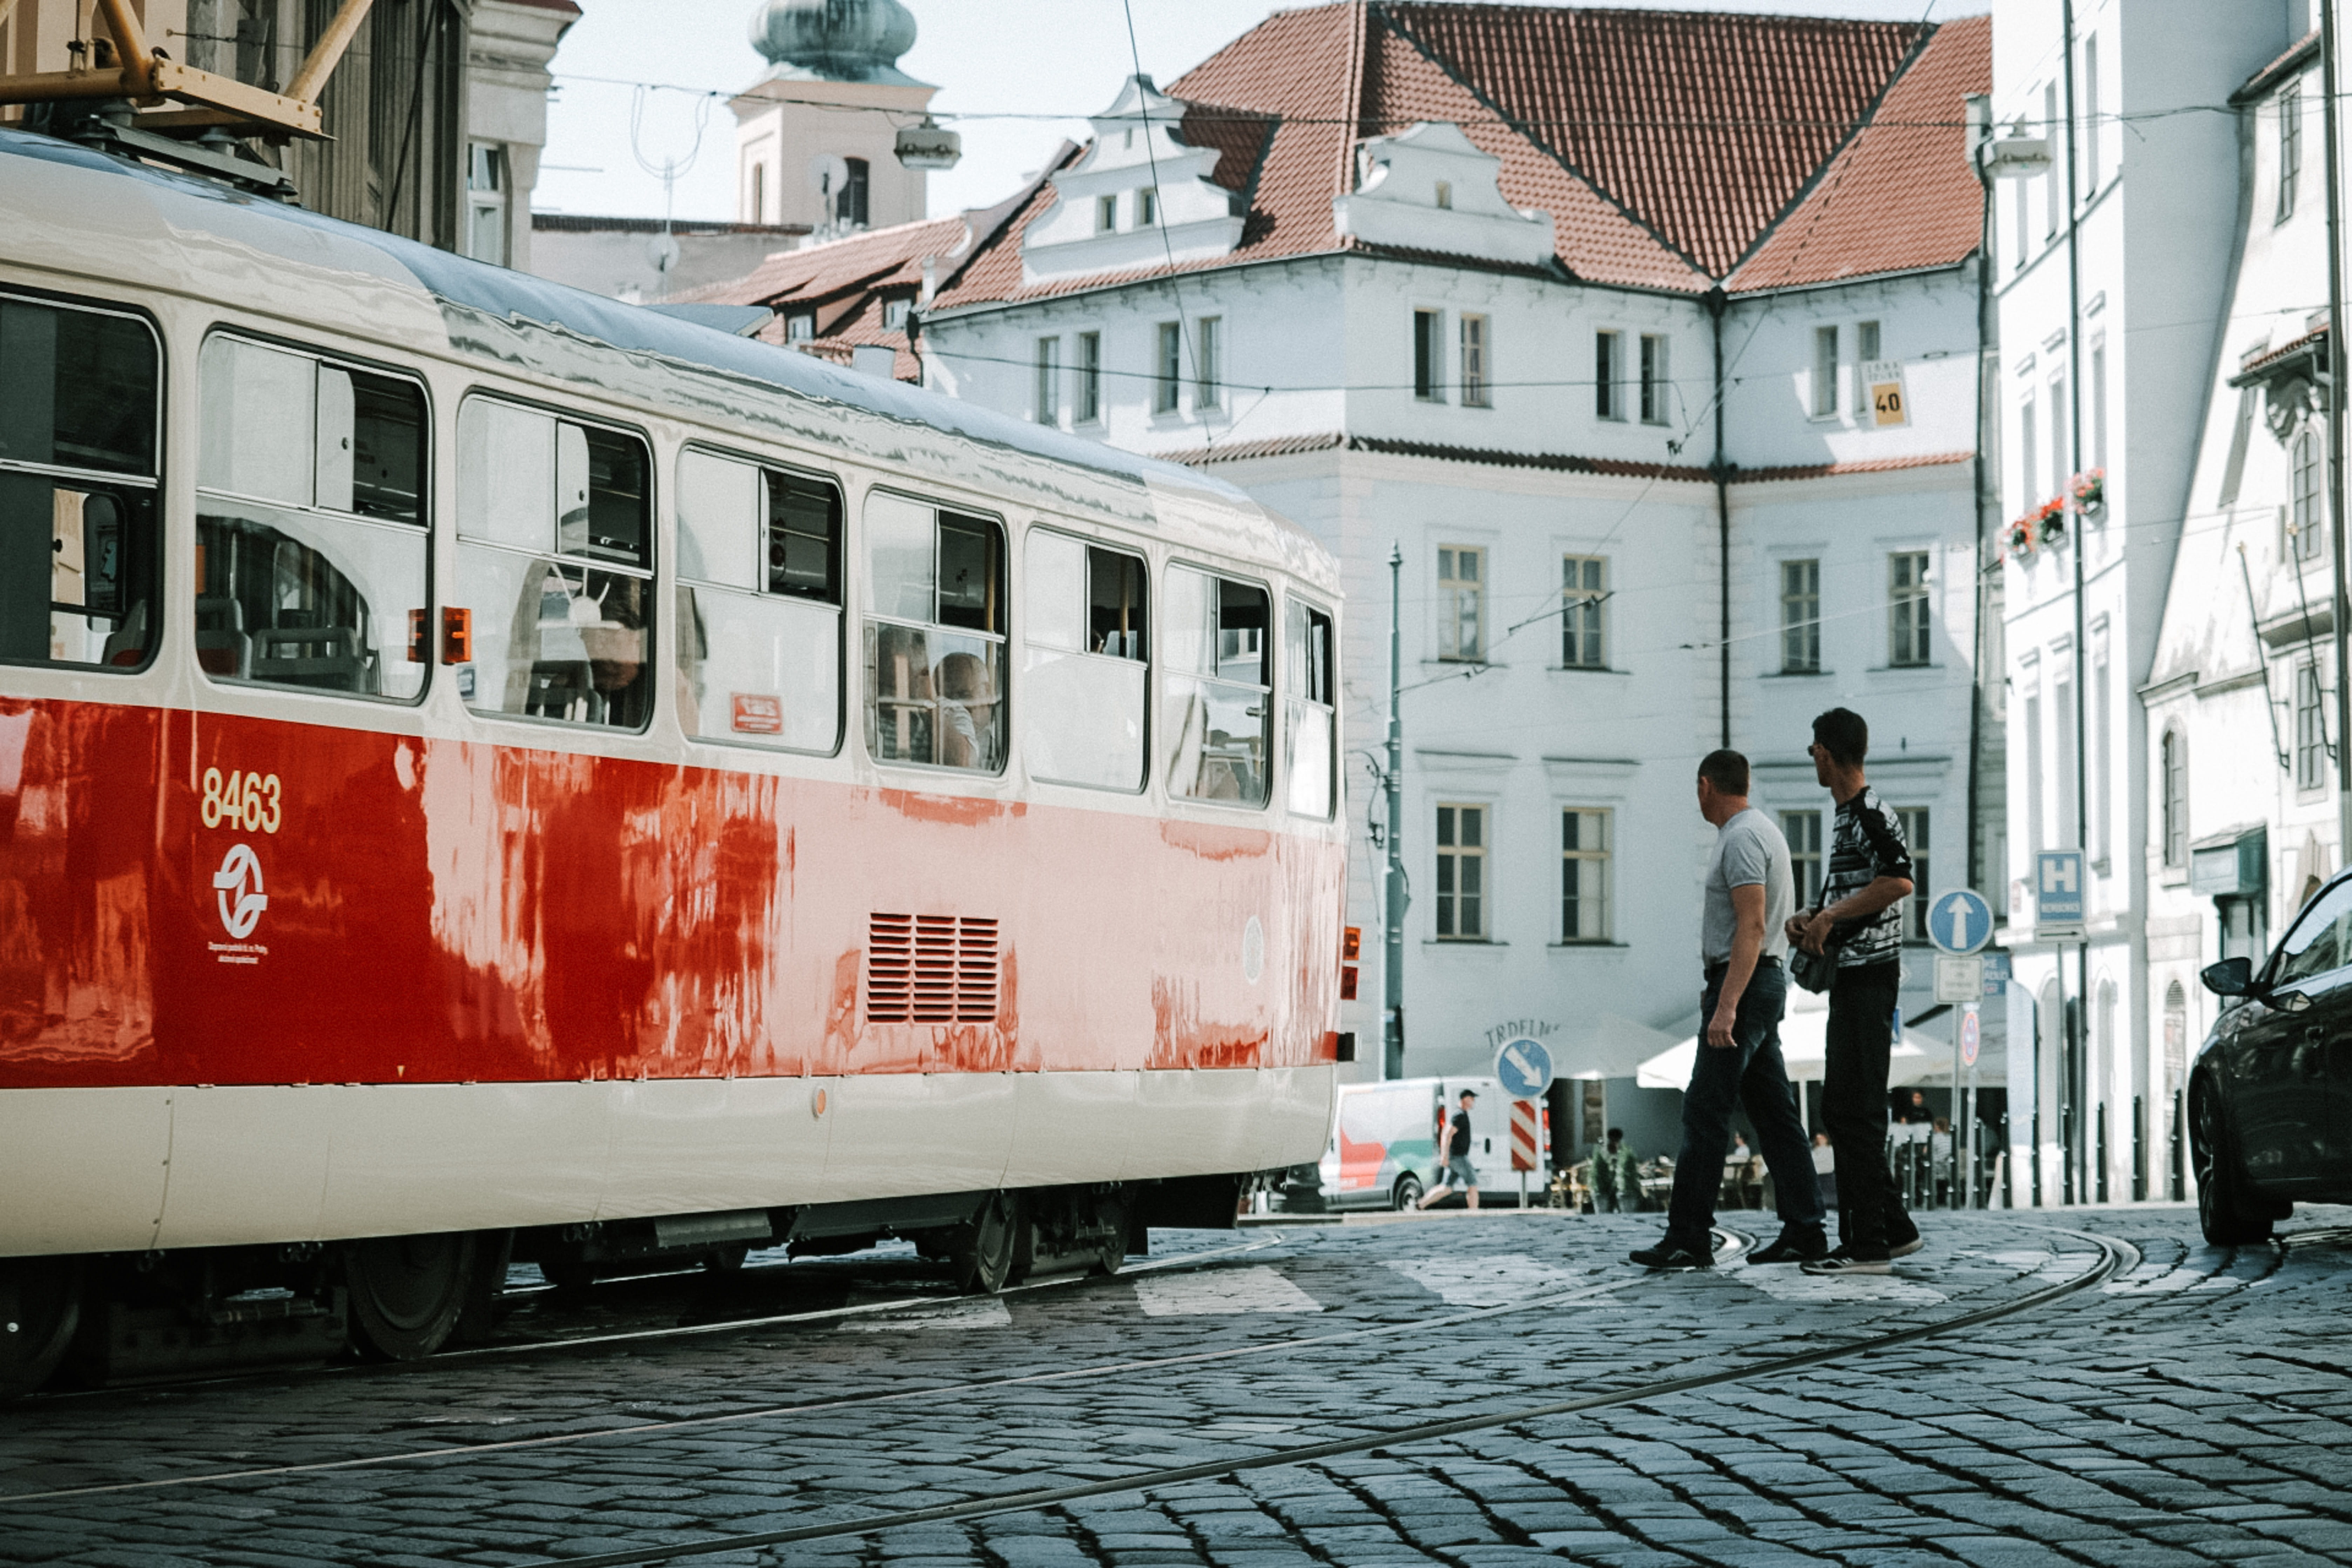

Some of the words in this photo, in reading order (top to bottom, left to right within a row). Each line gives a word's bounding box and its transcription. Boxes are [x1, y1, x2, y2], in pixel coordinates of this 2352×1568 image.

[1876, 392, 1900, 413] 40
[201, 767, 281, 833] 8463
[2042, 858, 2077, 893] H
